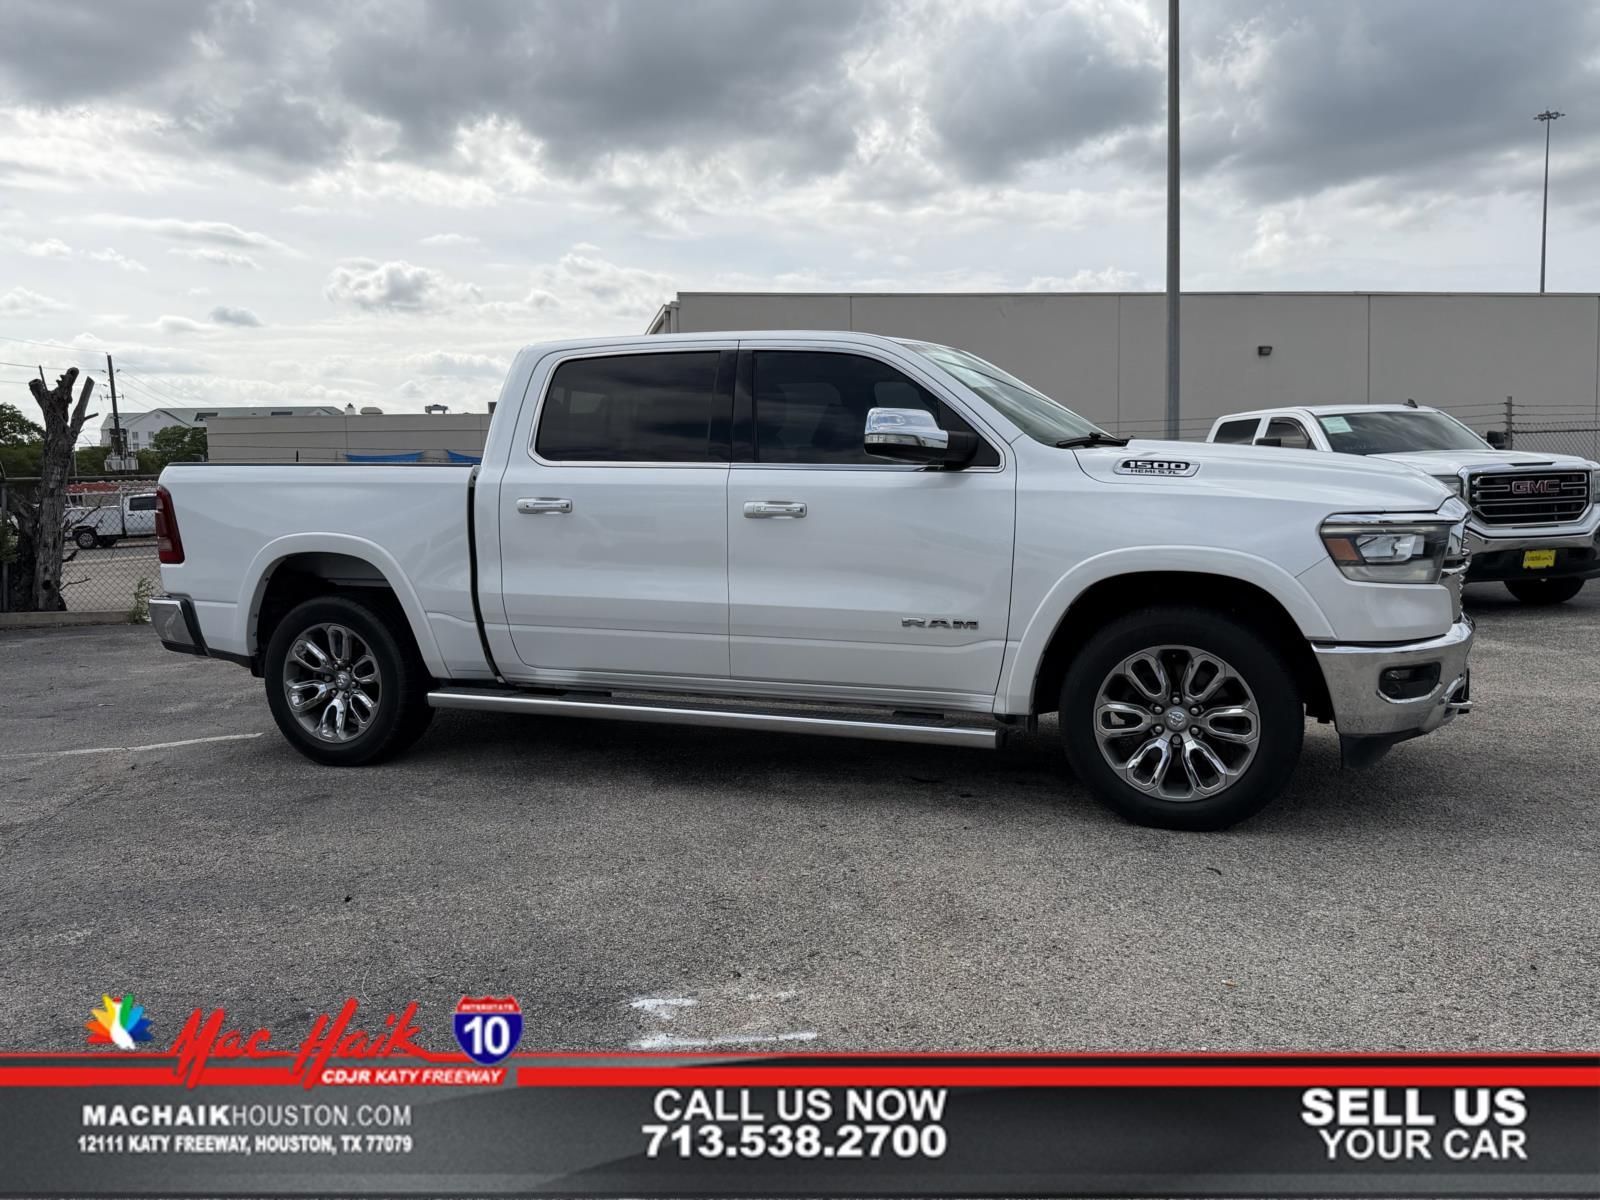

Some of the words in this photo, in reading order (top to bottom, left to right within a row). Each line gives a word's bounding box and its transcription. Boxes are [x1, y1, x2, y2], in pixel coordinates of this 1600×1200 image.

[1128, 461, 1187, 470] 1500
[1511, 480, 1560, 494] GMC
[901, 616, 979, 630] RAM
